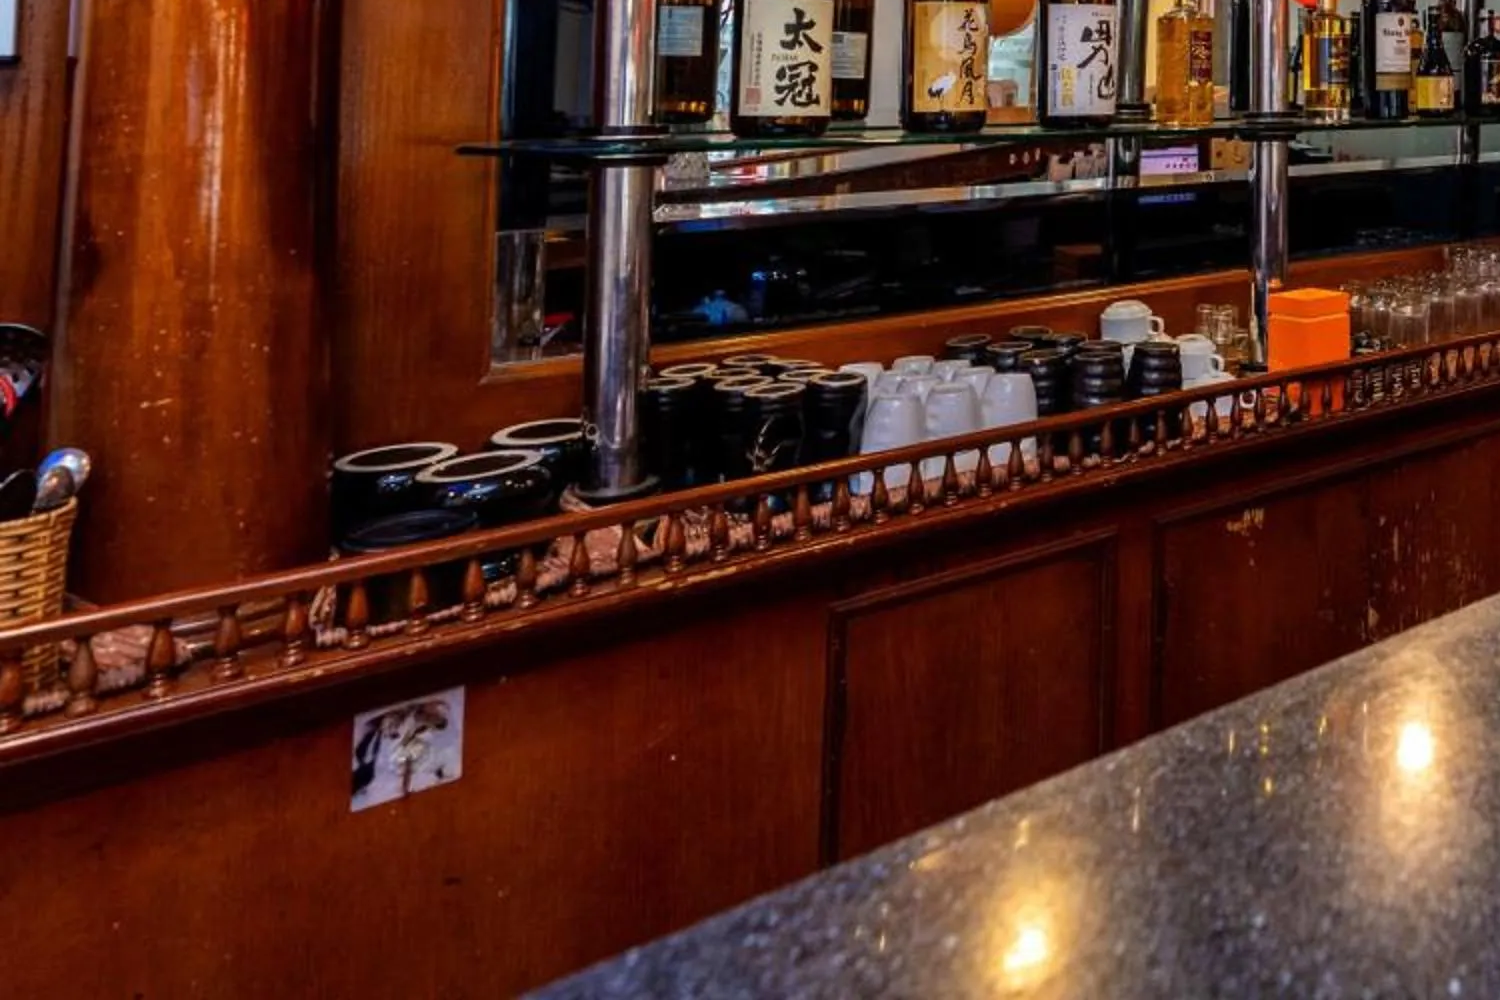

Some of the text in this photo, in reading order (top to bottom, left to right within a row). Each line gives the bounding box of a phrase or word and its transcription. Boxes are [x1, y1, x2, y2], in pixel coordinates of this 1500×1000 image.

[774, 7, 824, 108] 太冠
[957, 8, 982, 105] 花鳥風月
